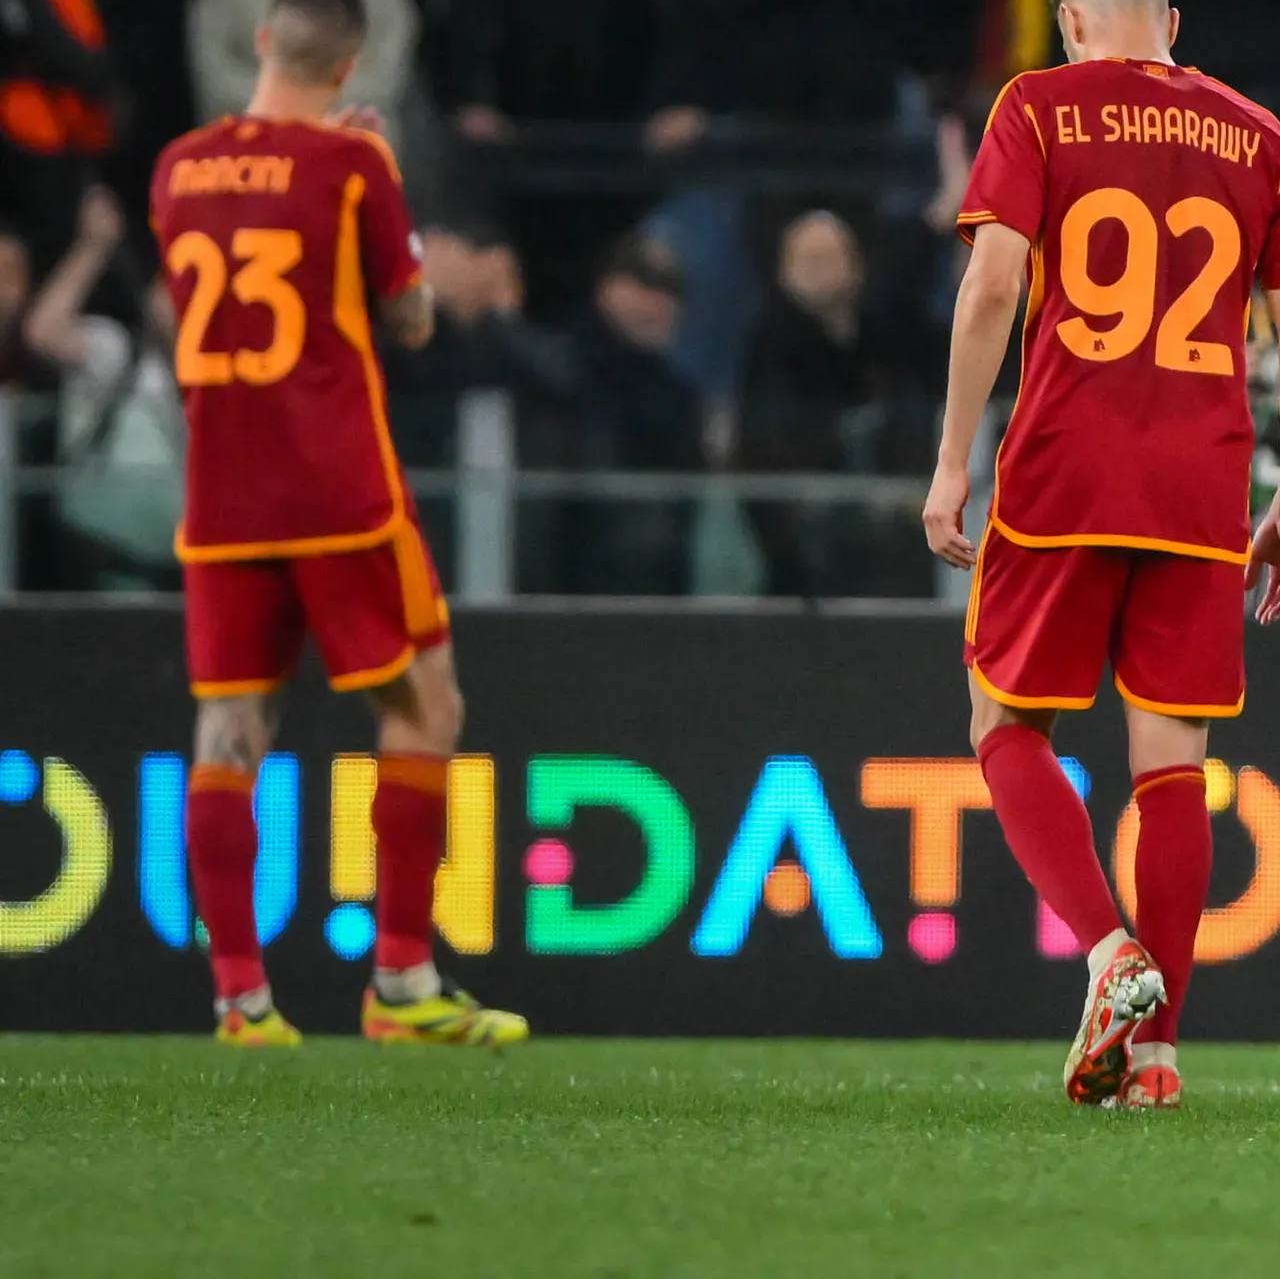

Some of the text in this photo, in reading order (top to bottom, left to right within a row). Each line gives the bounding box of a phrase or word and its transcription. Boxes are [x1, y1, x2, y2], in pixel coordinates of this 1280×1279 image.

[1055, 104, 1261, 168] EL SHAARAWY
[167, 229, 306, 386] 23
[1056, 187, 1242, 377] 92
